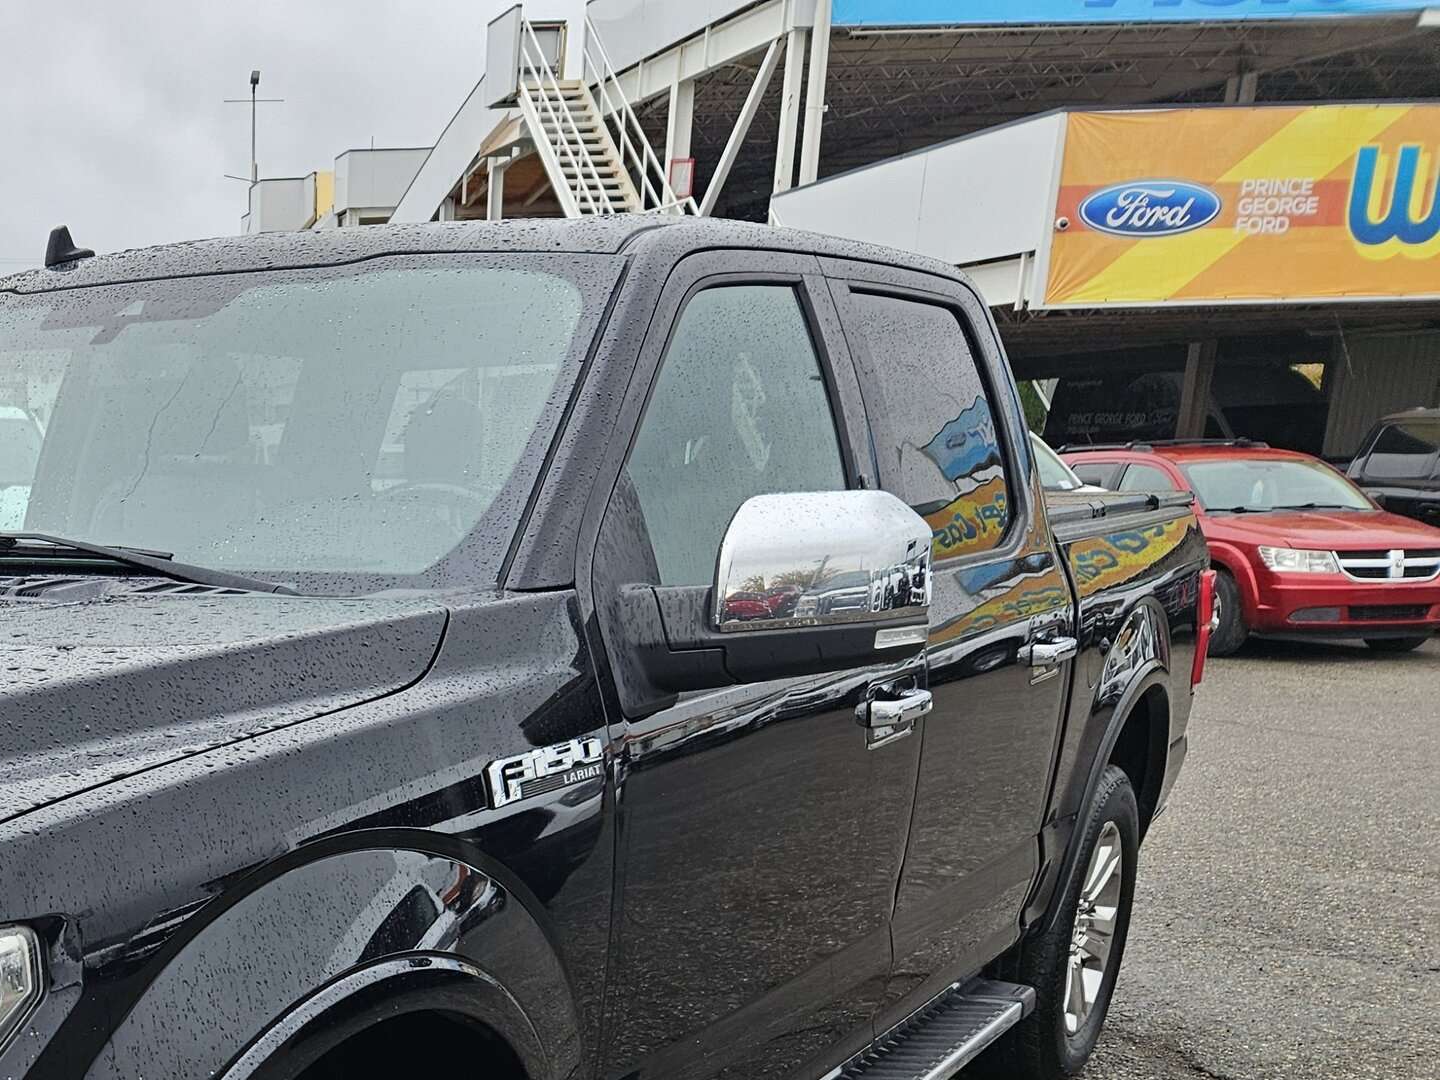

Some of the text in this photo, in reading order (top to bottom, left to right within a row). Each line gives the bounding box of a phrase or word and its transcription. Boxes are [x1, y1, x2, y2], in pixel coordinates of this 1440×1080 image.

[1240, 177, 1315, 196] PRINCE
[1106, 187, 1196, 229] Ford
[1237, 196, 1320, 214] GEORGE
[1234, 215, 1291, 234] FORD
[563, 764, 602, 785] LARIAT
